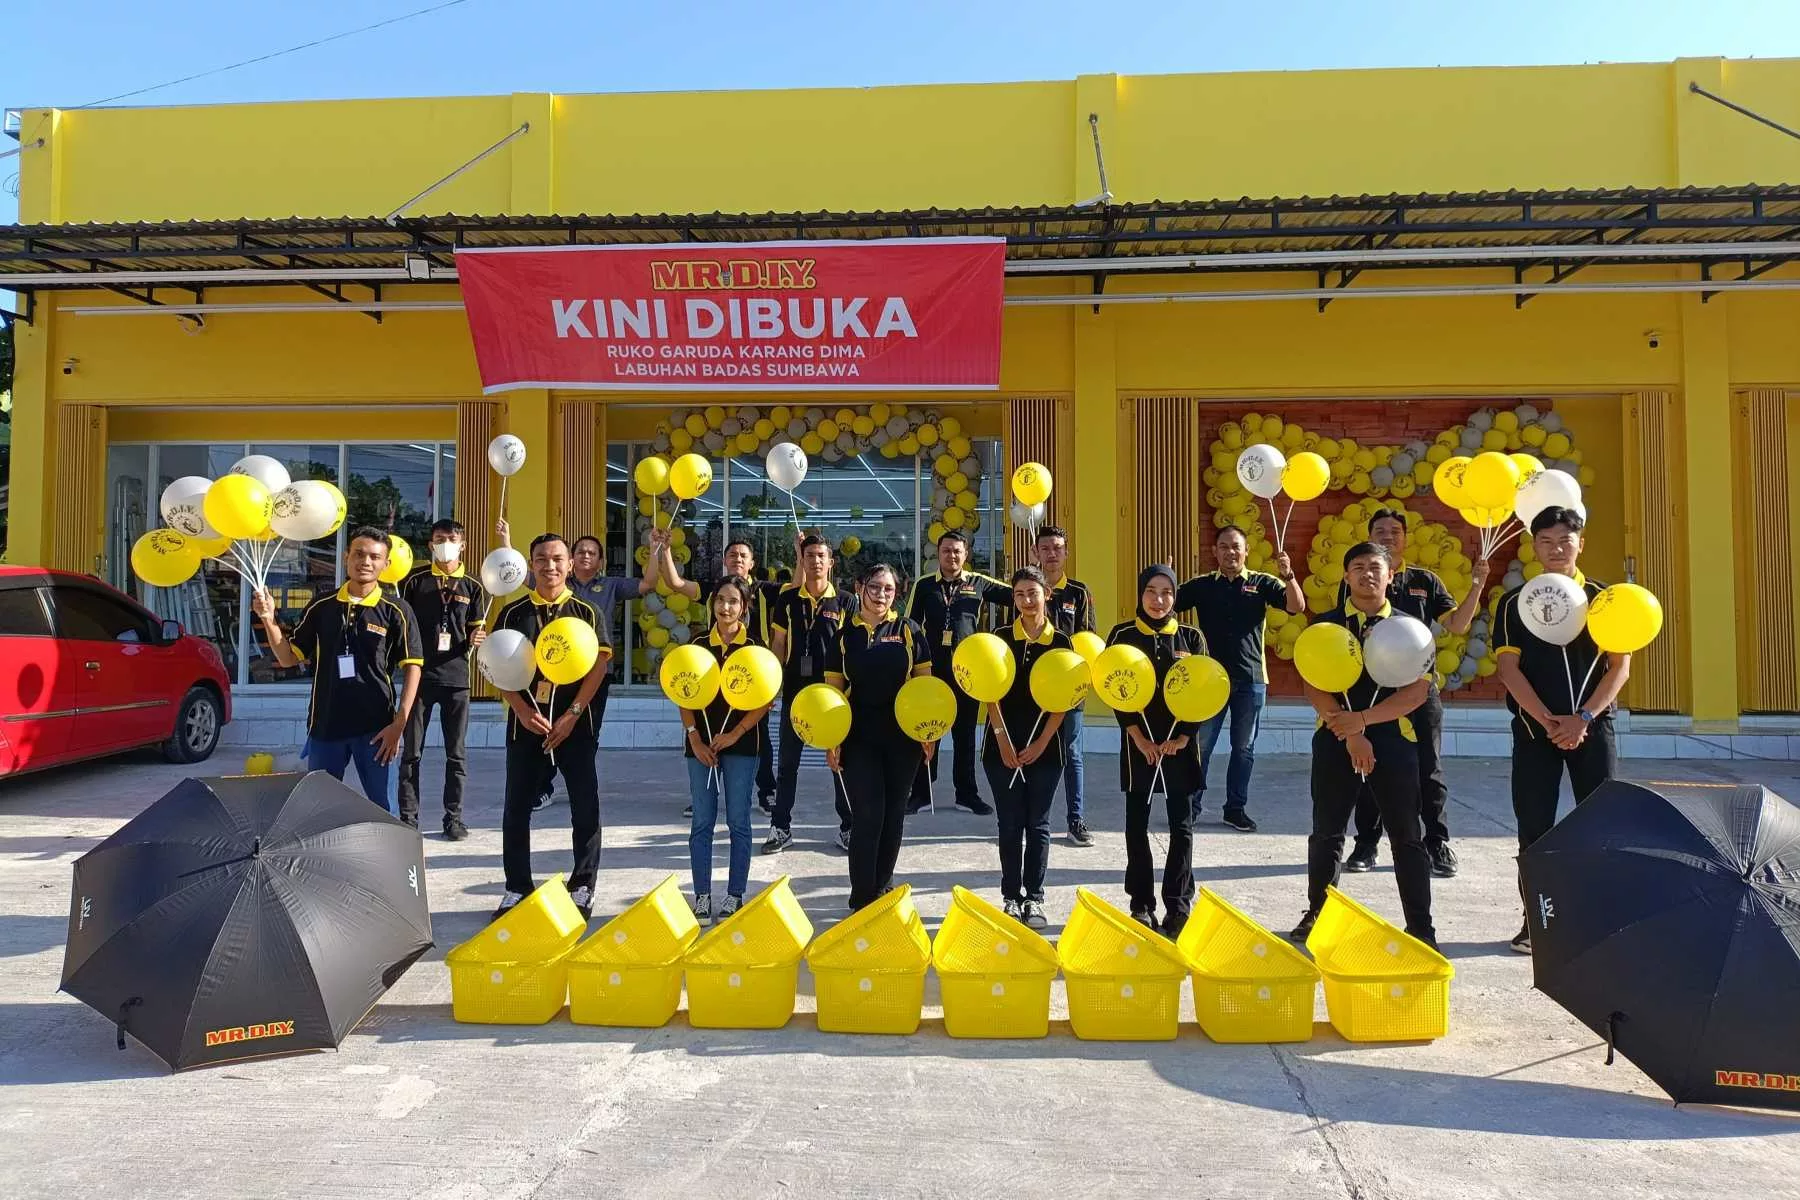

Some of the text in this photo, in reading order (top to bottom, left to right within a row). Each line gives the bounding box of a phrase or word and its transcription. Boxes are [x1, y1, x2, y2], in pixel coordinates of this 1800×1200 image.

[551, 297, 918, 338] KINI DIBUKA
[607, 345, 866, 359] RUKO GARUDA KARANG DIMA
[615, 363, 860, 377] LABUHAN BADAS SUMBAWA
